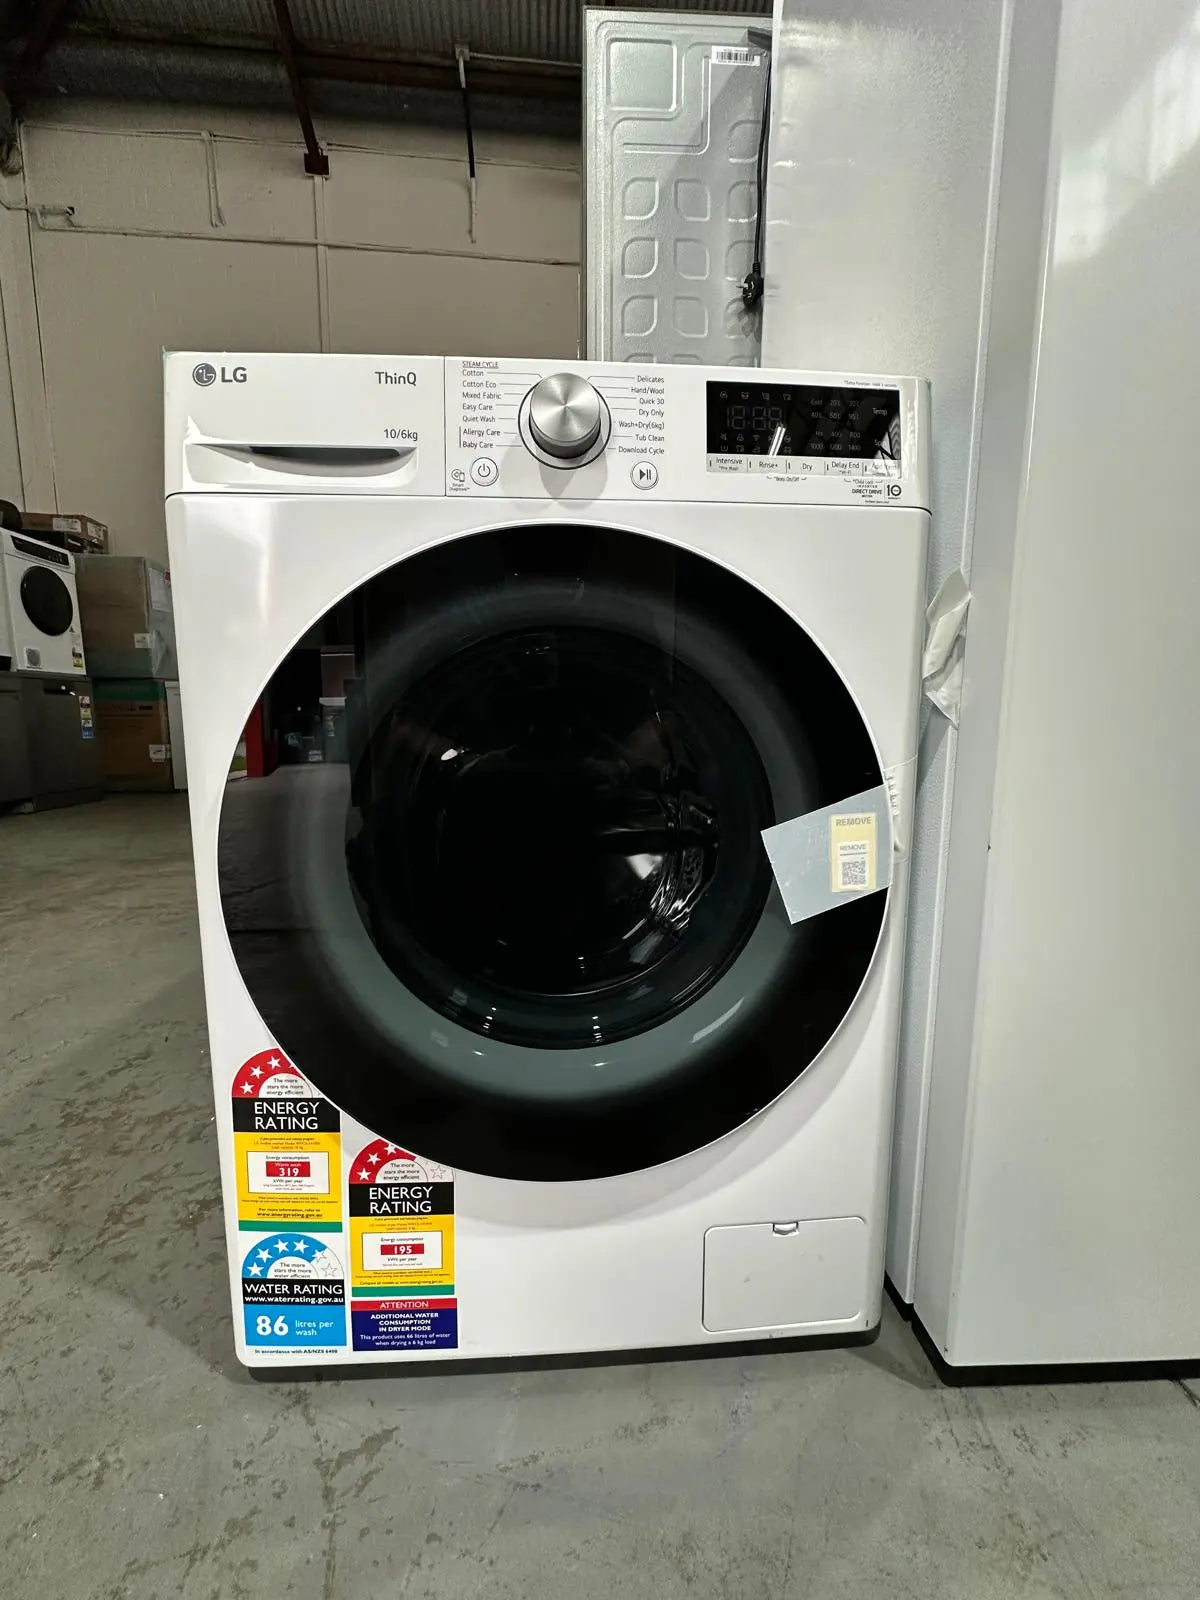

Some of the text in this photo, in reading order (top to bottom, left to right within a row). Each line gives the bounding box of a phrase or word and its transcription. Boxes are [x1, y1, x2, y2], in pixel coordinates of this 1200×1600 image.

[221, 366, 247, 383] LG
[374, 371, 417, 387] ThinQ
[631, 386, 664, 394] Hand/Wool
[482, 392, 502, 400] Fabric
[462, 403, 476, 412] Easy
[872, 408, 888, 416] Temp
[638, 409, 664, 418] Dry Only
[619, 420, 664, 430] Wash+Dry(6kg)
[384, 428, 418, 441] 10/6kg
[463, 428, 484, 437] Allergy
[648, 434, 664, 442] Clean
[462, 442, 478, 450] Baby
[618, 446, 664, 455] Download Cycle
[716, 457, 743, 465] Intensive
[832, 461, 847, 469] Delay
[802, 463, 812, 471] Dry
[836, 816, 872, 828] REMOVE
[840, 843, 867, 851] REMOVE
[254, 1102, 320, 1115] ENERGY
[255, 1116, 318, 1130] RATING
[279, 1167, 299, 1176] 319
[369, 1186, 433, 1200] ENERGY
[370, 1201, 432, 1214] RATING
[394, 1246, 412, 1254] 195
[244, 1284, 343, 1295] WATER RATING
[244, 1296, 344, 1304] www.waterrating.gov.au
[380, 1301, 429, 1309] ATTENTION
[256, 1315, 334, 1336] 86 litres per
[296, 1328, 317, 1336] wash
